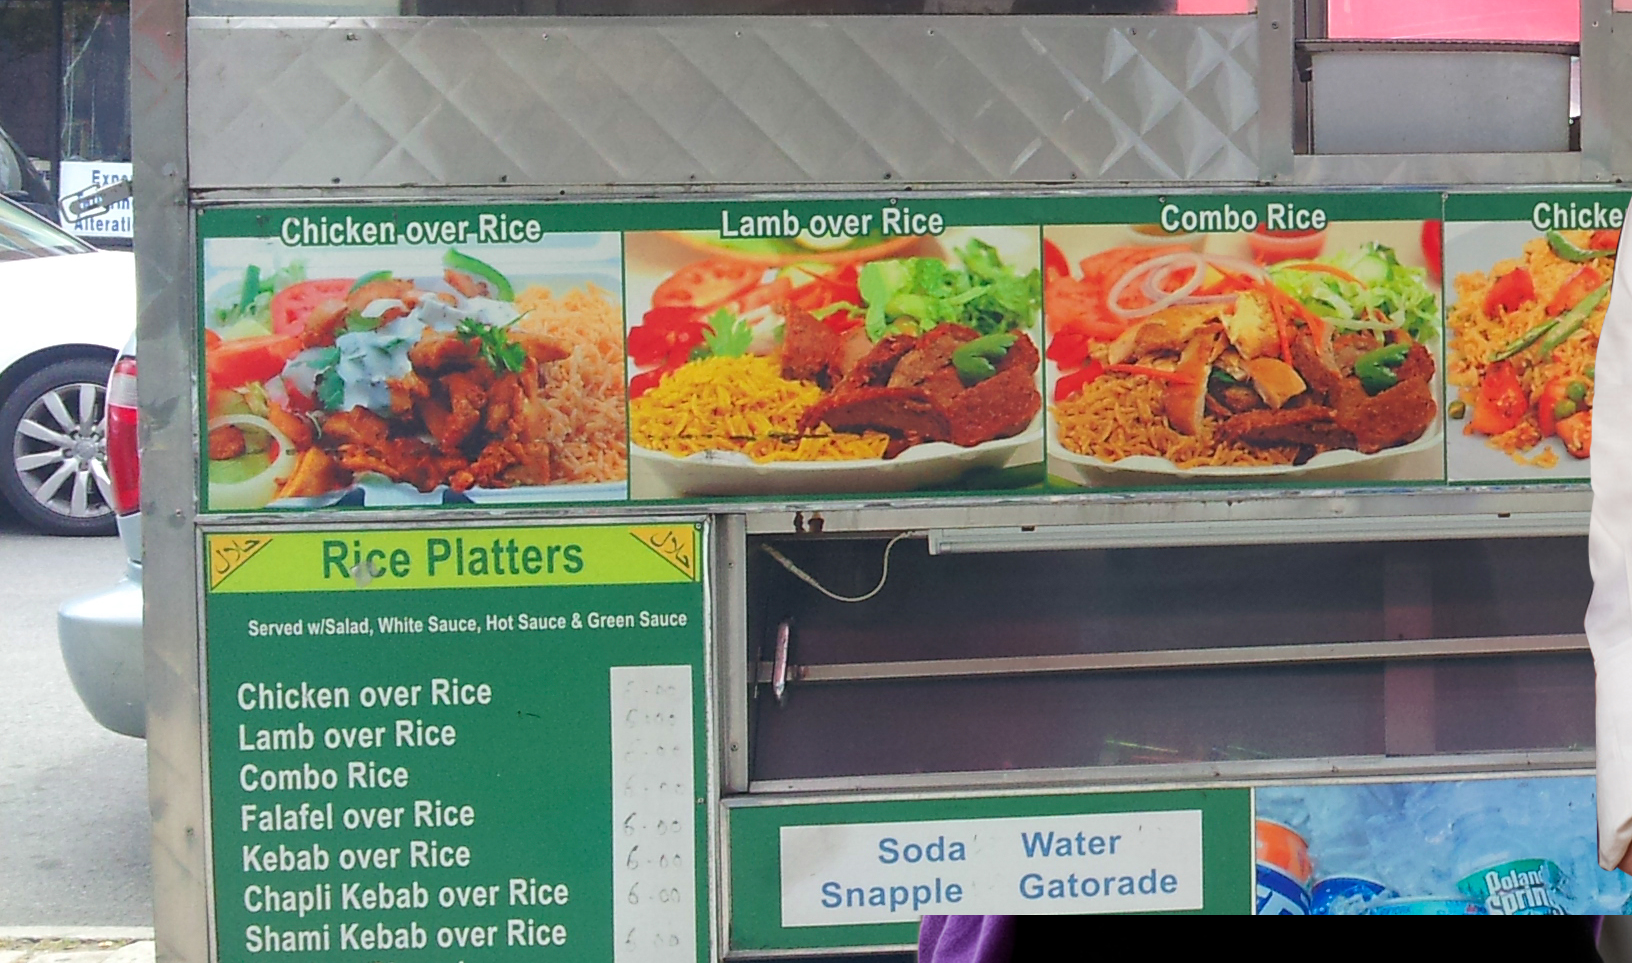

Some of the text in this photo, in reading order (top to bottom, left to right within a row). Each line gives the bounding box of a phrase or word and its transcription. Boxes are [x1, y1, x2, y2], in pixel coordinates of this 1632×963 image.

[282, 213, 542, 246] Chicken over Rice
[721, 207, 943, 239] Lamb over Rice
[1161, 202, 1327, 233] Combo Rice
[1533, 202, 1627, 229] Chicke
[324, 538, 583, 578] Rice Platters
[248, 610, 687, 637] Served w/Salad, White Sauce, Hot Sauce & Green Sauce
[238, 679, 491, 710] Chicken over Rice
[240, 720, 455, 750] Lamb over Rice
[240, 762, 408, 791] Combo Rice
[242, 800, 474, 831] Falafel over Rice
[243, 841, 470, 871] Kebab over Rice
[878, 836, 966, 864] Soda
[1020, 831, 1121, 858] Water
[245, 879, 568, 917] Chapli Kebab over Rice
[820, 877, 963, 913] Snapple
[1018, 868, 1178, 900] Gatorade
[246, 919, 566, 952] Shami Kebab over Rice
